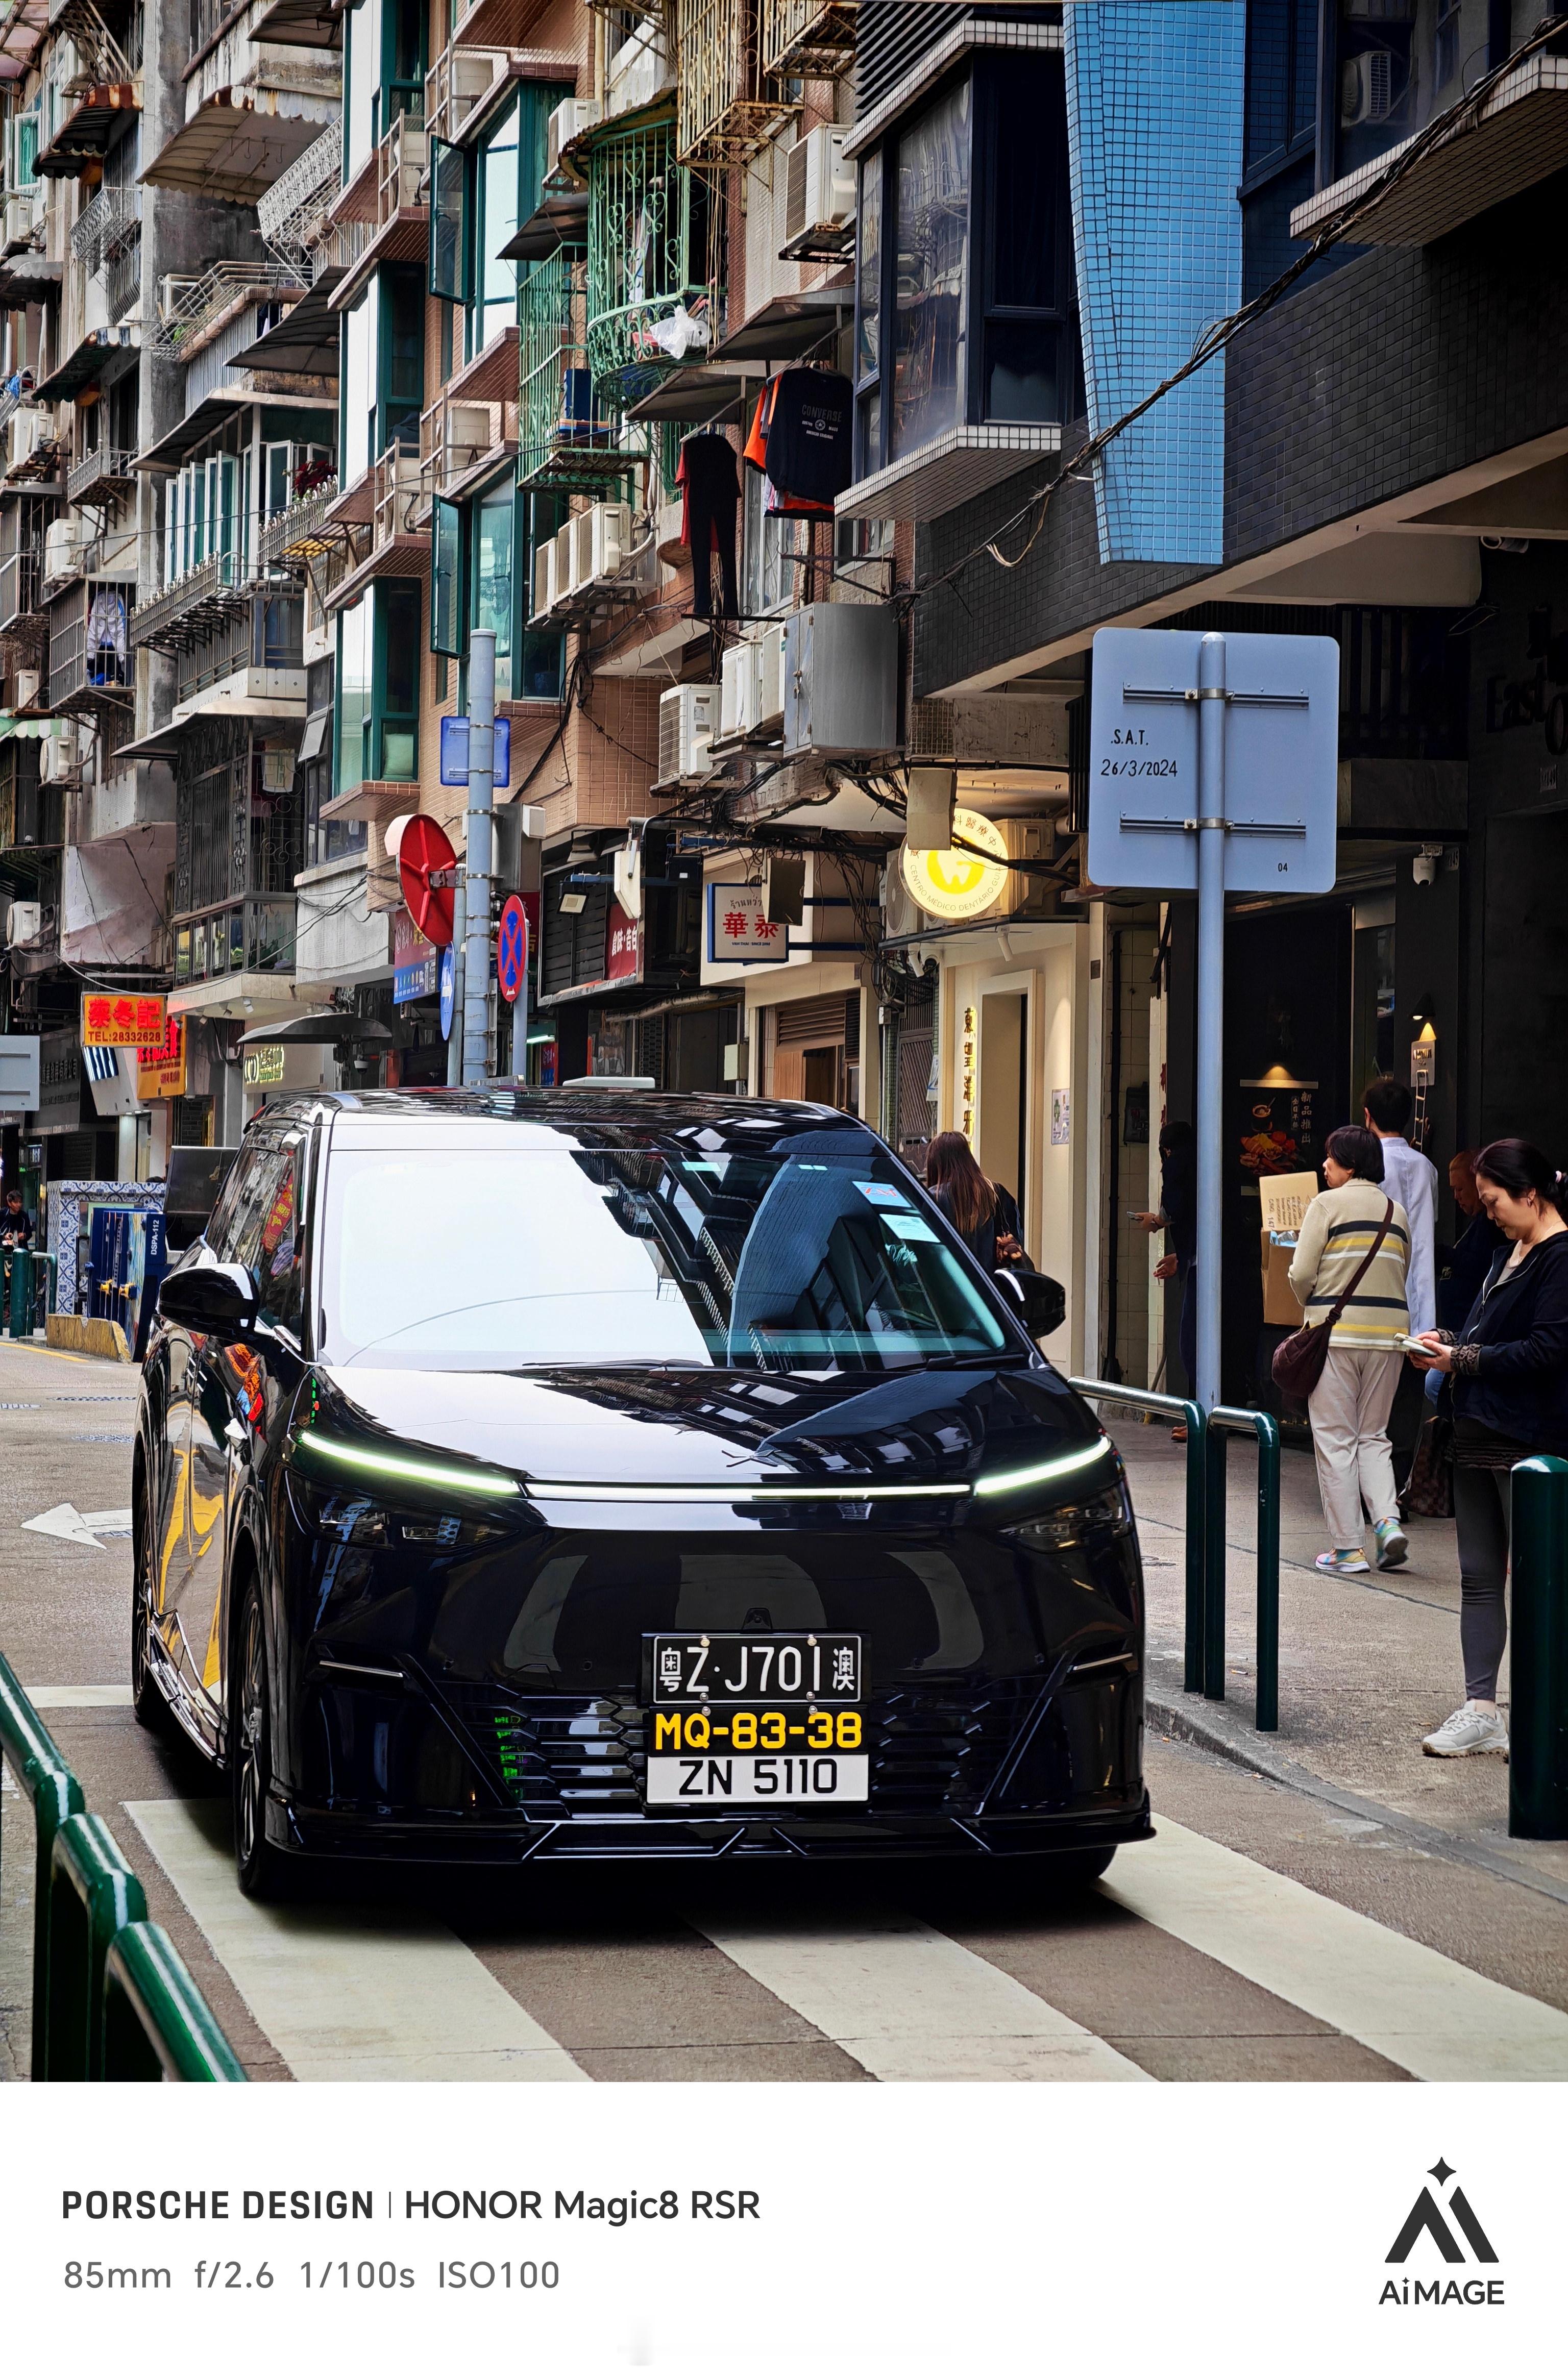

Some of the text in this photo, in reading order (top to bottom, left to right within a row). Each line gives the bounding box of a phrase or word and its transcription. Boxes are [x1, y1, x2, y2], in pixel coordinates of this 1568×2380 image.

[802, 405, 842, 422] CONVERSE
[1100, 759, 1178, 778] 26/3/2024
[1278, 862, 1288, 872] 04
[910, 864, 927, 897] CENTRO
[926, 895, 957, 911] MÉDICO
[959, 888, 994, 911] DENTÁRIO
[723, 911, 779, 939] 華泰
[88, 1031, 161, 1042] TEL:28332628
[150, 1219, 160, 1255] DSPA-112
[655, 1712, 862, 1750] MQ-83-38
[679, 1758, 837, 1795] ZN 5110
